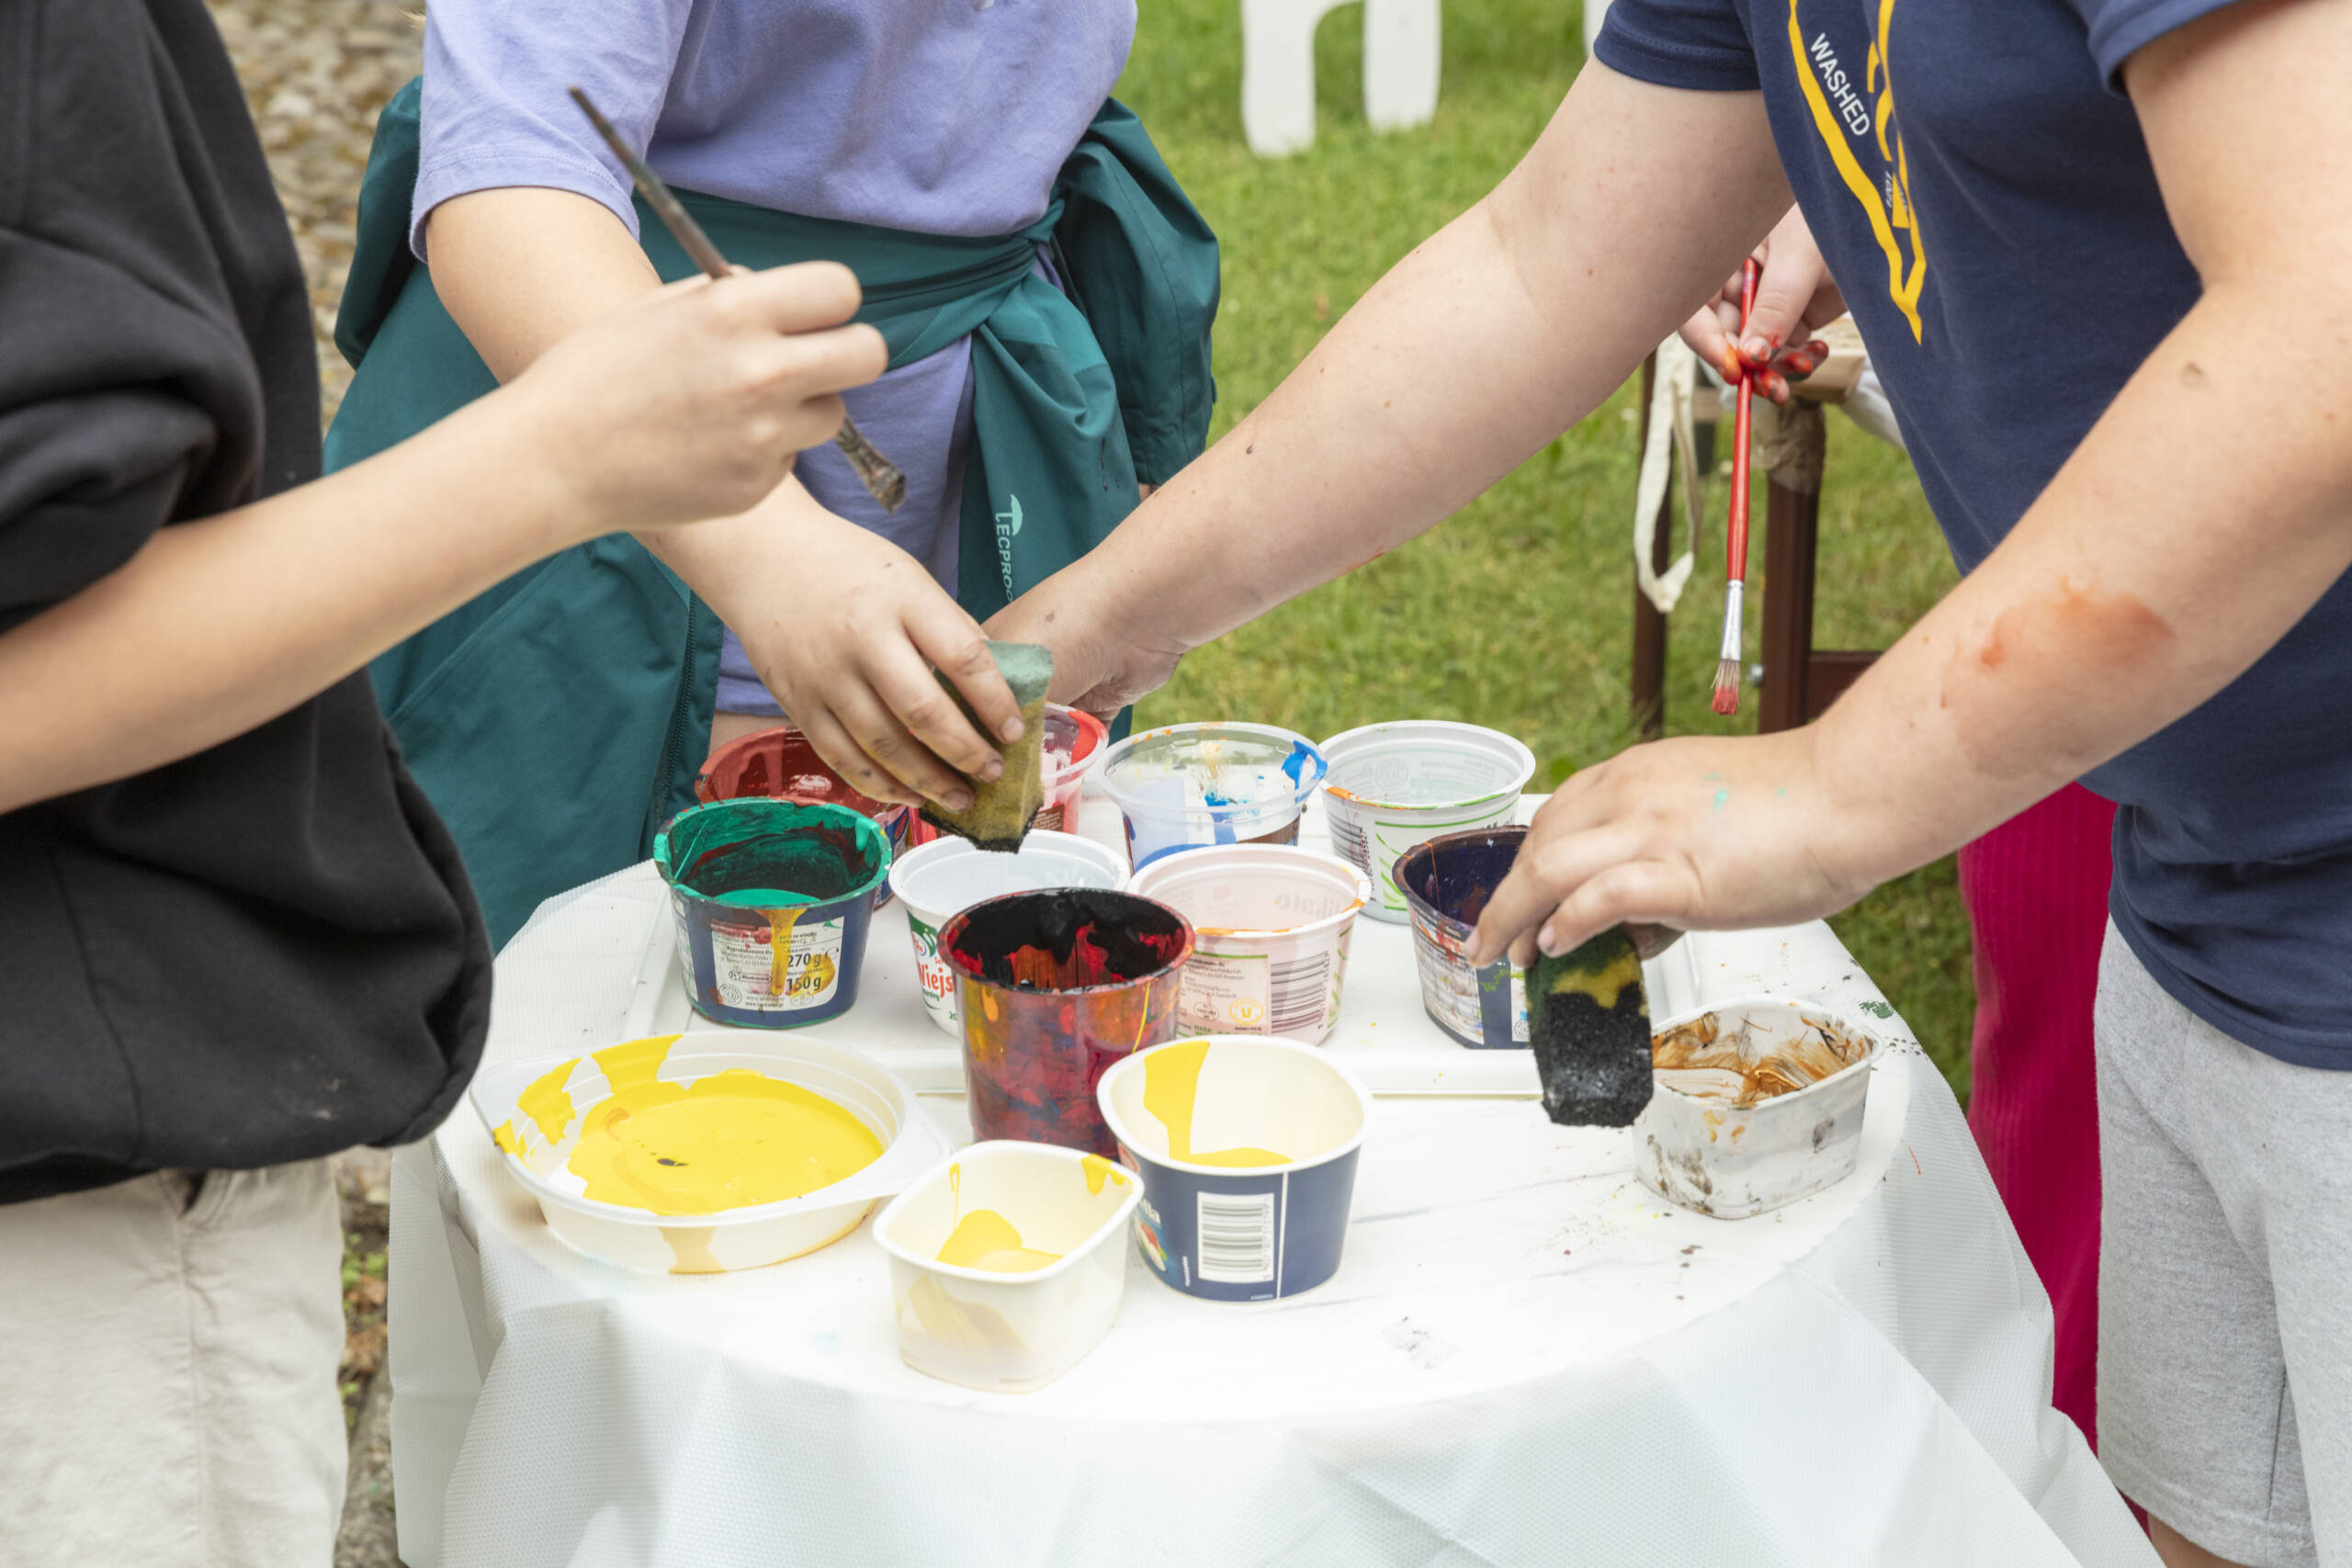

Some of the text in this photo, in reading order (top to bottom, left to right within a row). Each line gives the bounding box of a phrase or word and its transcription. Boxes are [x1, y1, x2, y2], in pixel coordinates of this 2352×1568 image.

[1810, 32, 1871, 137] WASHED
[787, 953, 811, 967] 270
[813, 953, 822, 967] g
[786, 976, 821, 992] 150 g
